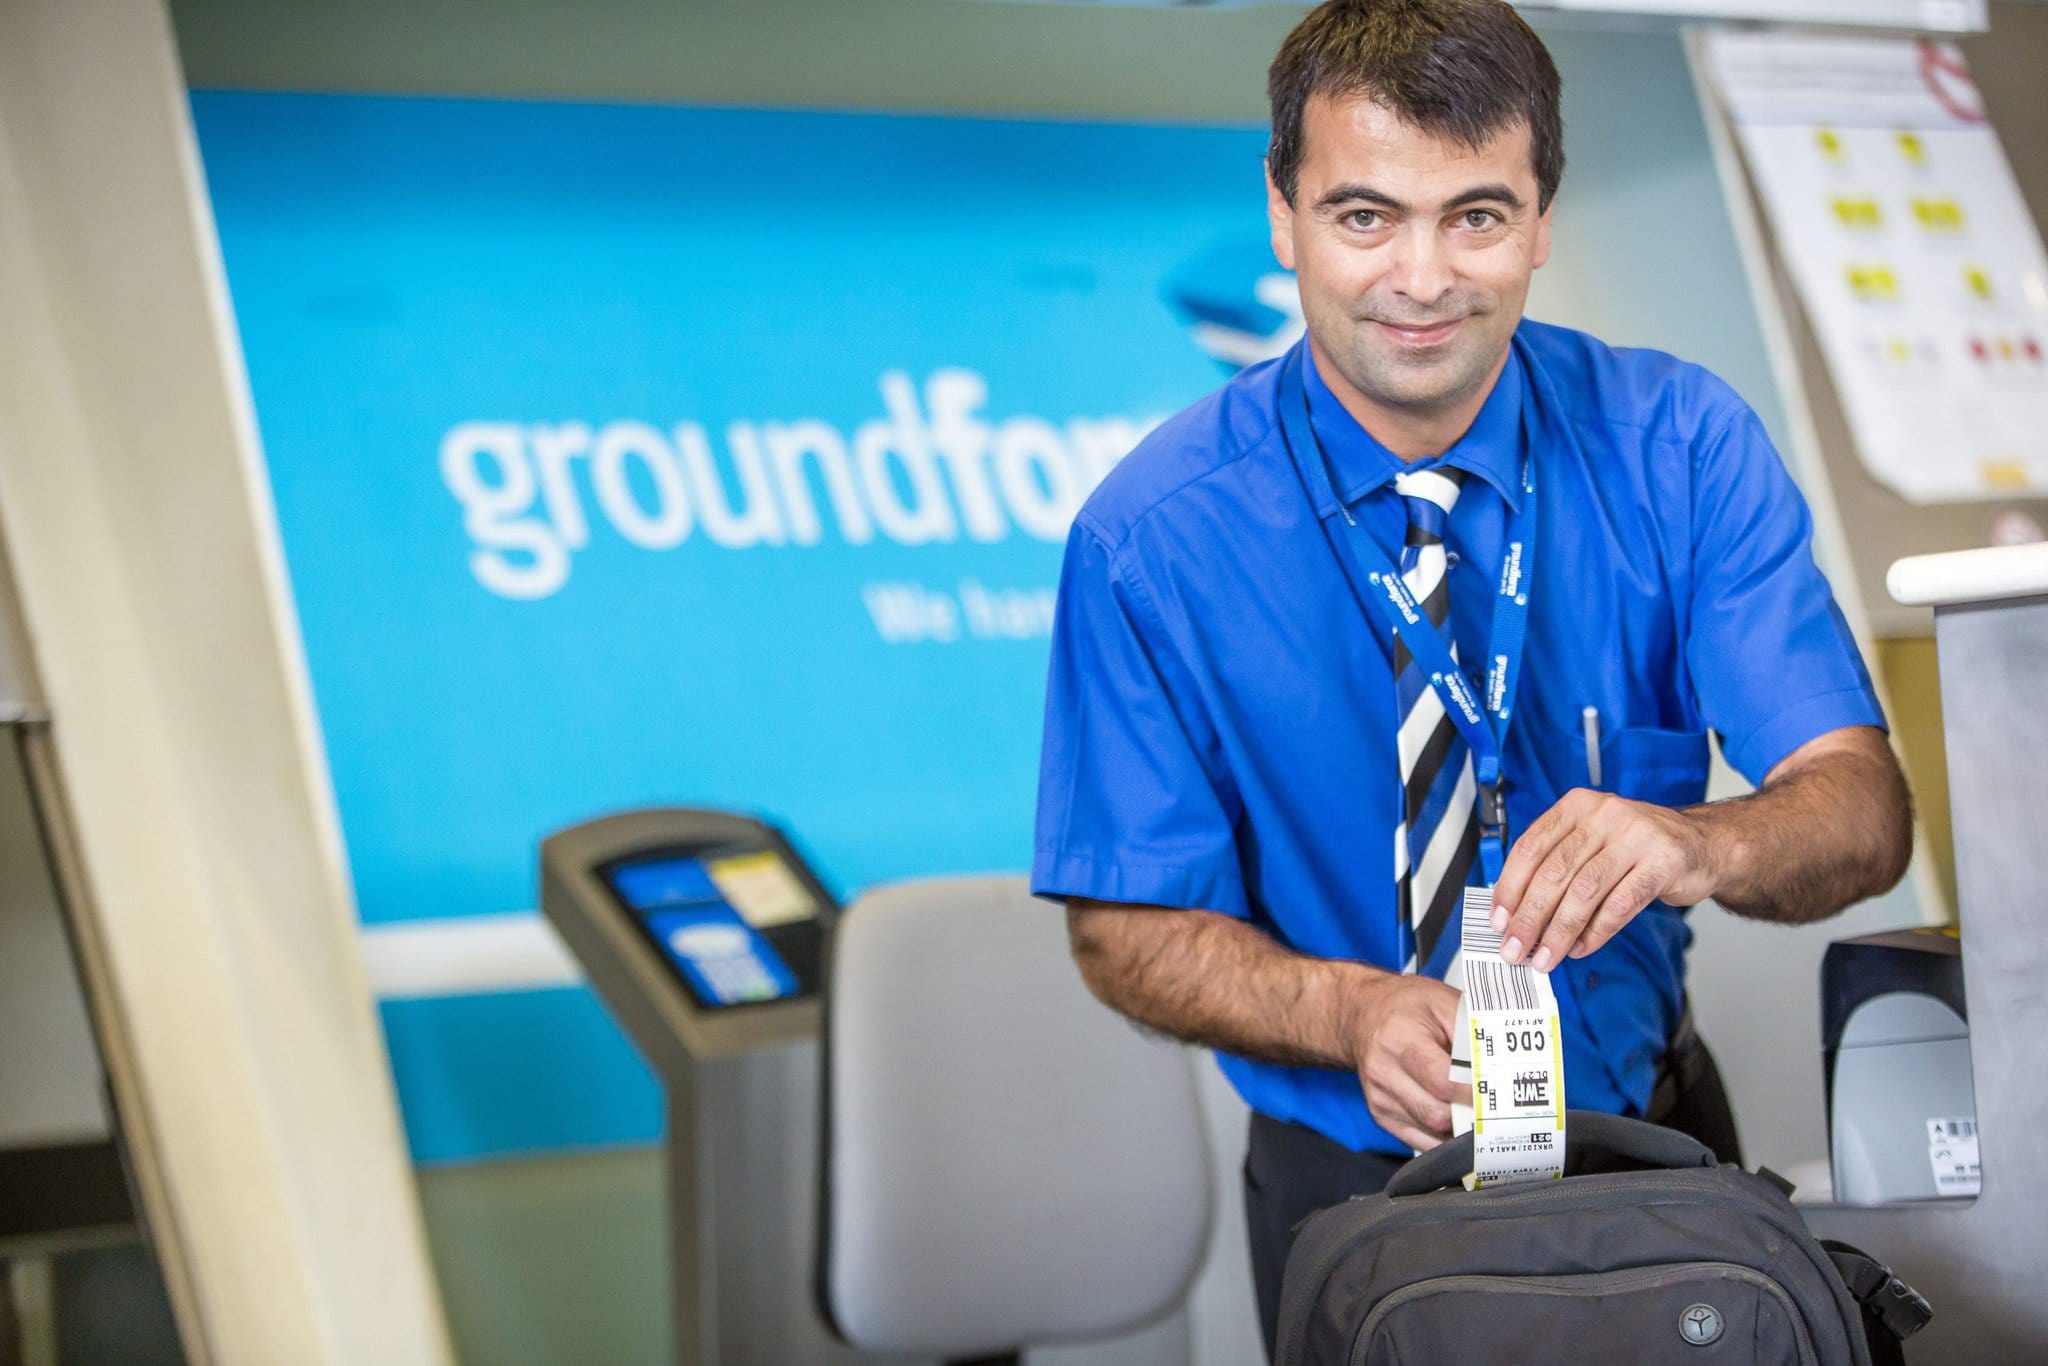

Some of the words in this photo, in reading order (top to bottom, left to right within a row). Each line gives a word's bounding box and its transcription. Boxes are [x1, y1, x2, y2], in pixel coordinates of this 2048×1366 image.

[439, 366, 1165, 599] groundfor
[1505, 1030, 1545, 1053] CDG
[1477, 1080, 1488, 1094] B
[1514, 1082, 1549, 1103] EWR
